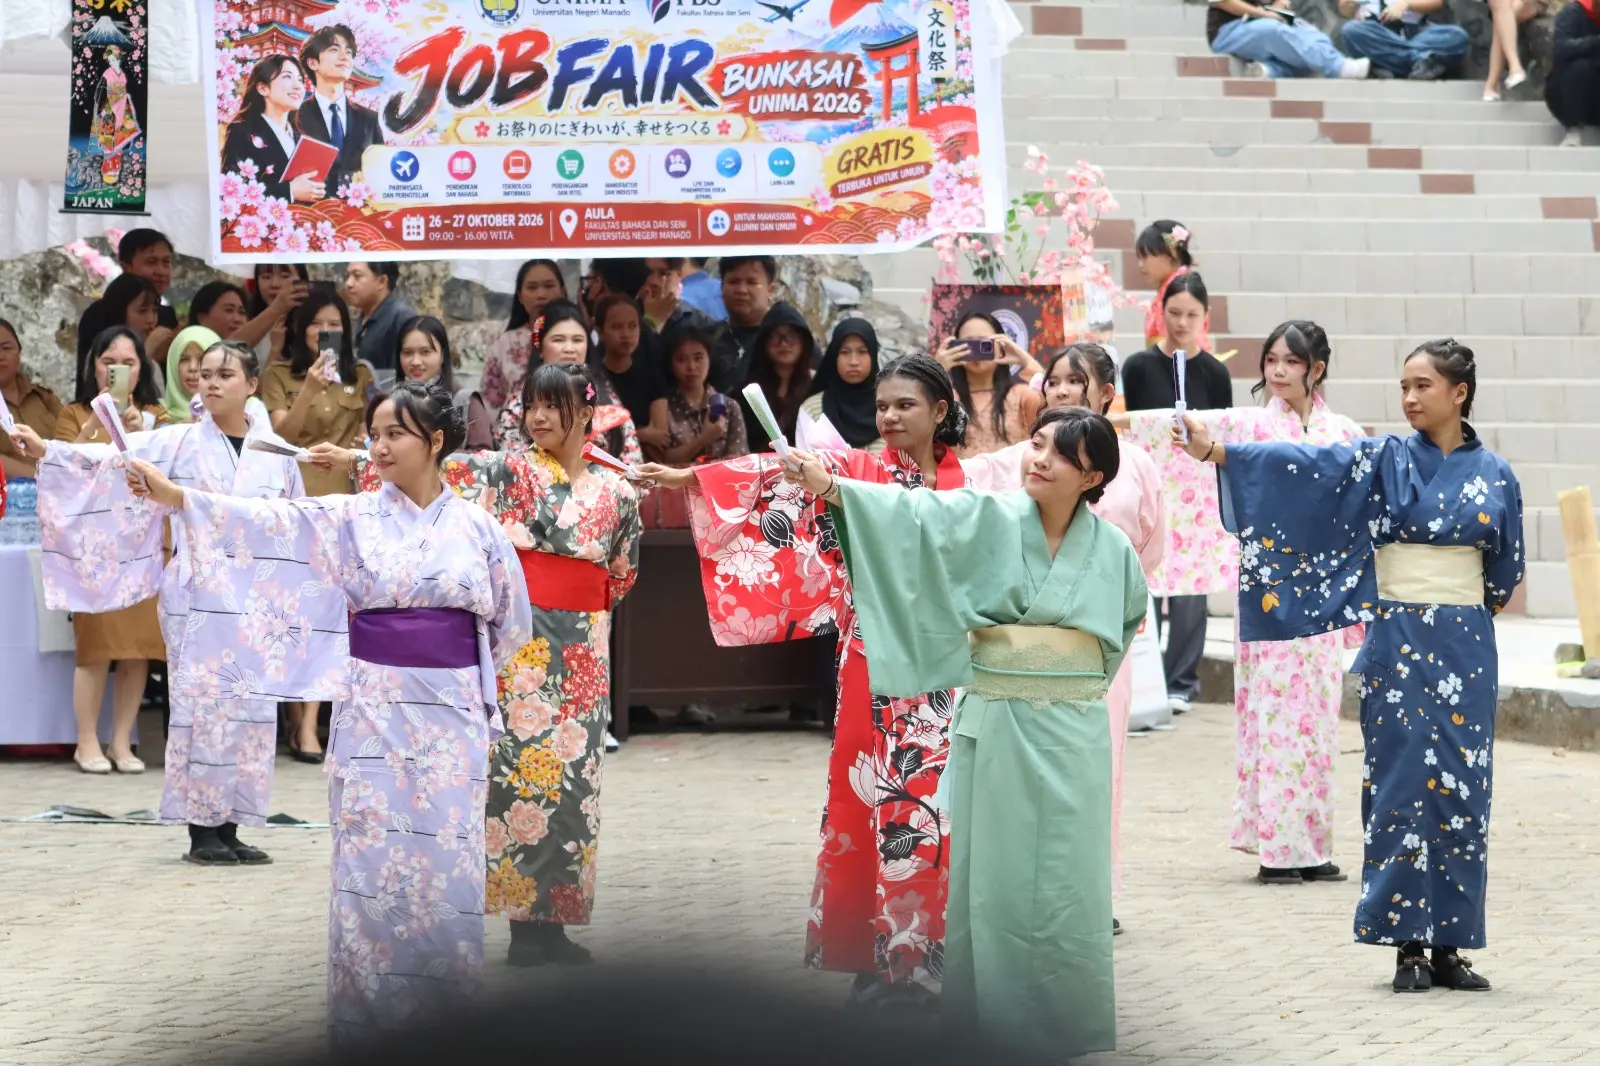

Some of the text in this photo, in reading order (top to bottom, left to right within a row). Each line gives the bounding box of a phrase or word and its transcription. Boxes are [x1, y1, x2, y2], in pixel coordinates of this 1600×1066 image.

[532, 8, 630, 17] Universitas Negeri Manado
[927, 8, 947, 71] 文化祭
[383, 26, 719, 134] JOB FAIR
[721, 58, 855, 97] BUNKASAI
[748, 92, 862, 114] UNIMA 2026
[496, 119, 710, 137] お祭りのにぎわいが、幸せをつくる
[837, 135, 915, 175] GRATIS
[837, 165, 925, 193] TERBUKA UNTUK UMUM
[72, 196, 114, 208] JAPAN
[584, 207, 615, 219] AULA
[734, 212, 756, 221] UNTUK
[429, 214, 442, 227] 26
[452, 214, 465, 227] 27
[467, 213, 515, 227] OKTOBER
[518, 213, 544, 226] 2026
[584, 220, 687, 230] FAKULTAS BAHASA DAN SENI
[734, 222, 797, 231] ALUMNI DAN UMUM
[429, 232, 454, 241] 09.00
[464, 231, 487, 240] 16.00
[490, 231, 514, 240] WITA
[585, 230, 692, 240] UNIVERSITAS NEGERI MANADO
